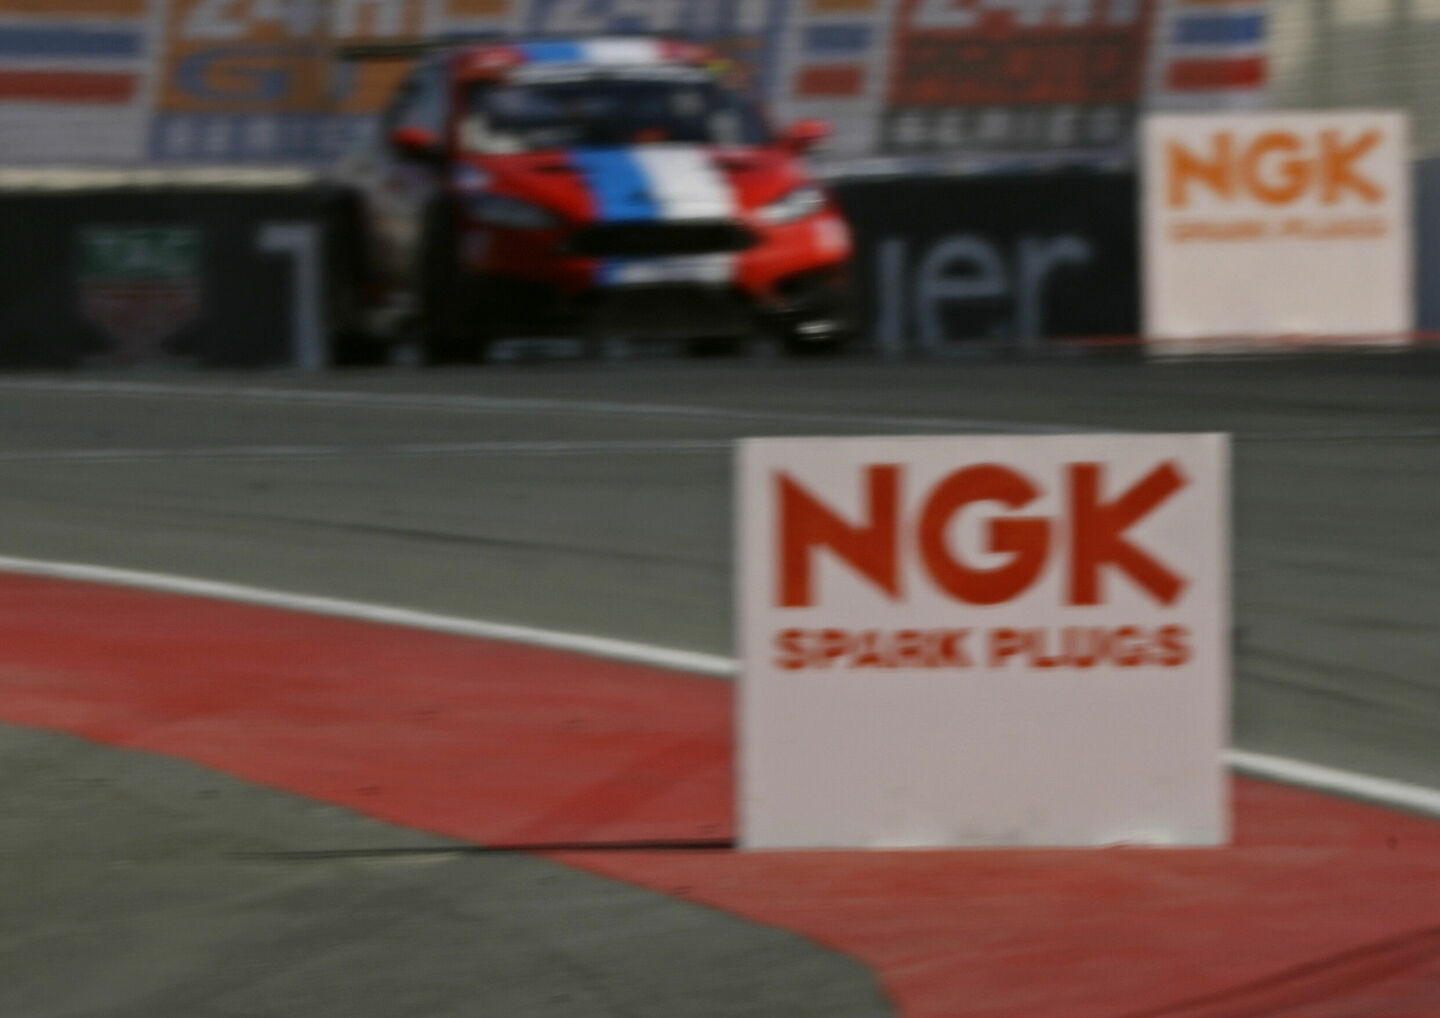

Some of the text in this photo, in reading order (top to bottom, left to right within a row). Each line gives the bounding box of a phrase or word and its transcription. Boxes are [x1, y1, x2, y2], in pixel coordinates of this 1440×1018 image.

[1167, 130, 1384, 208] NGK
[771, 459, 1192, 608] NGK
[773, 624, 1194, 672] SPARK PLUGS
